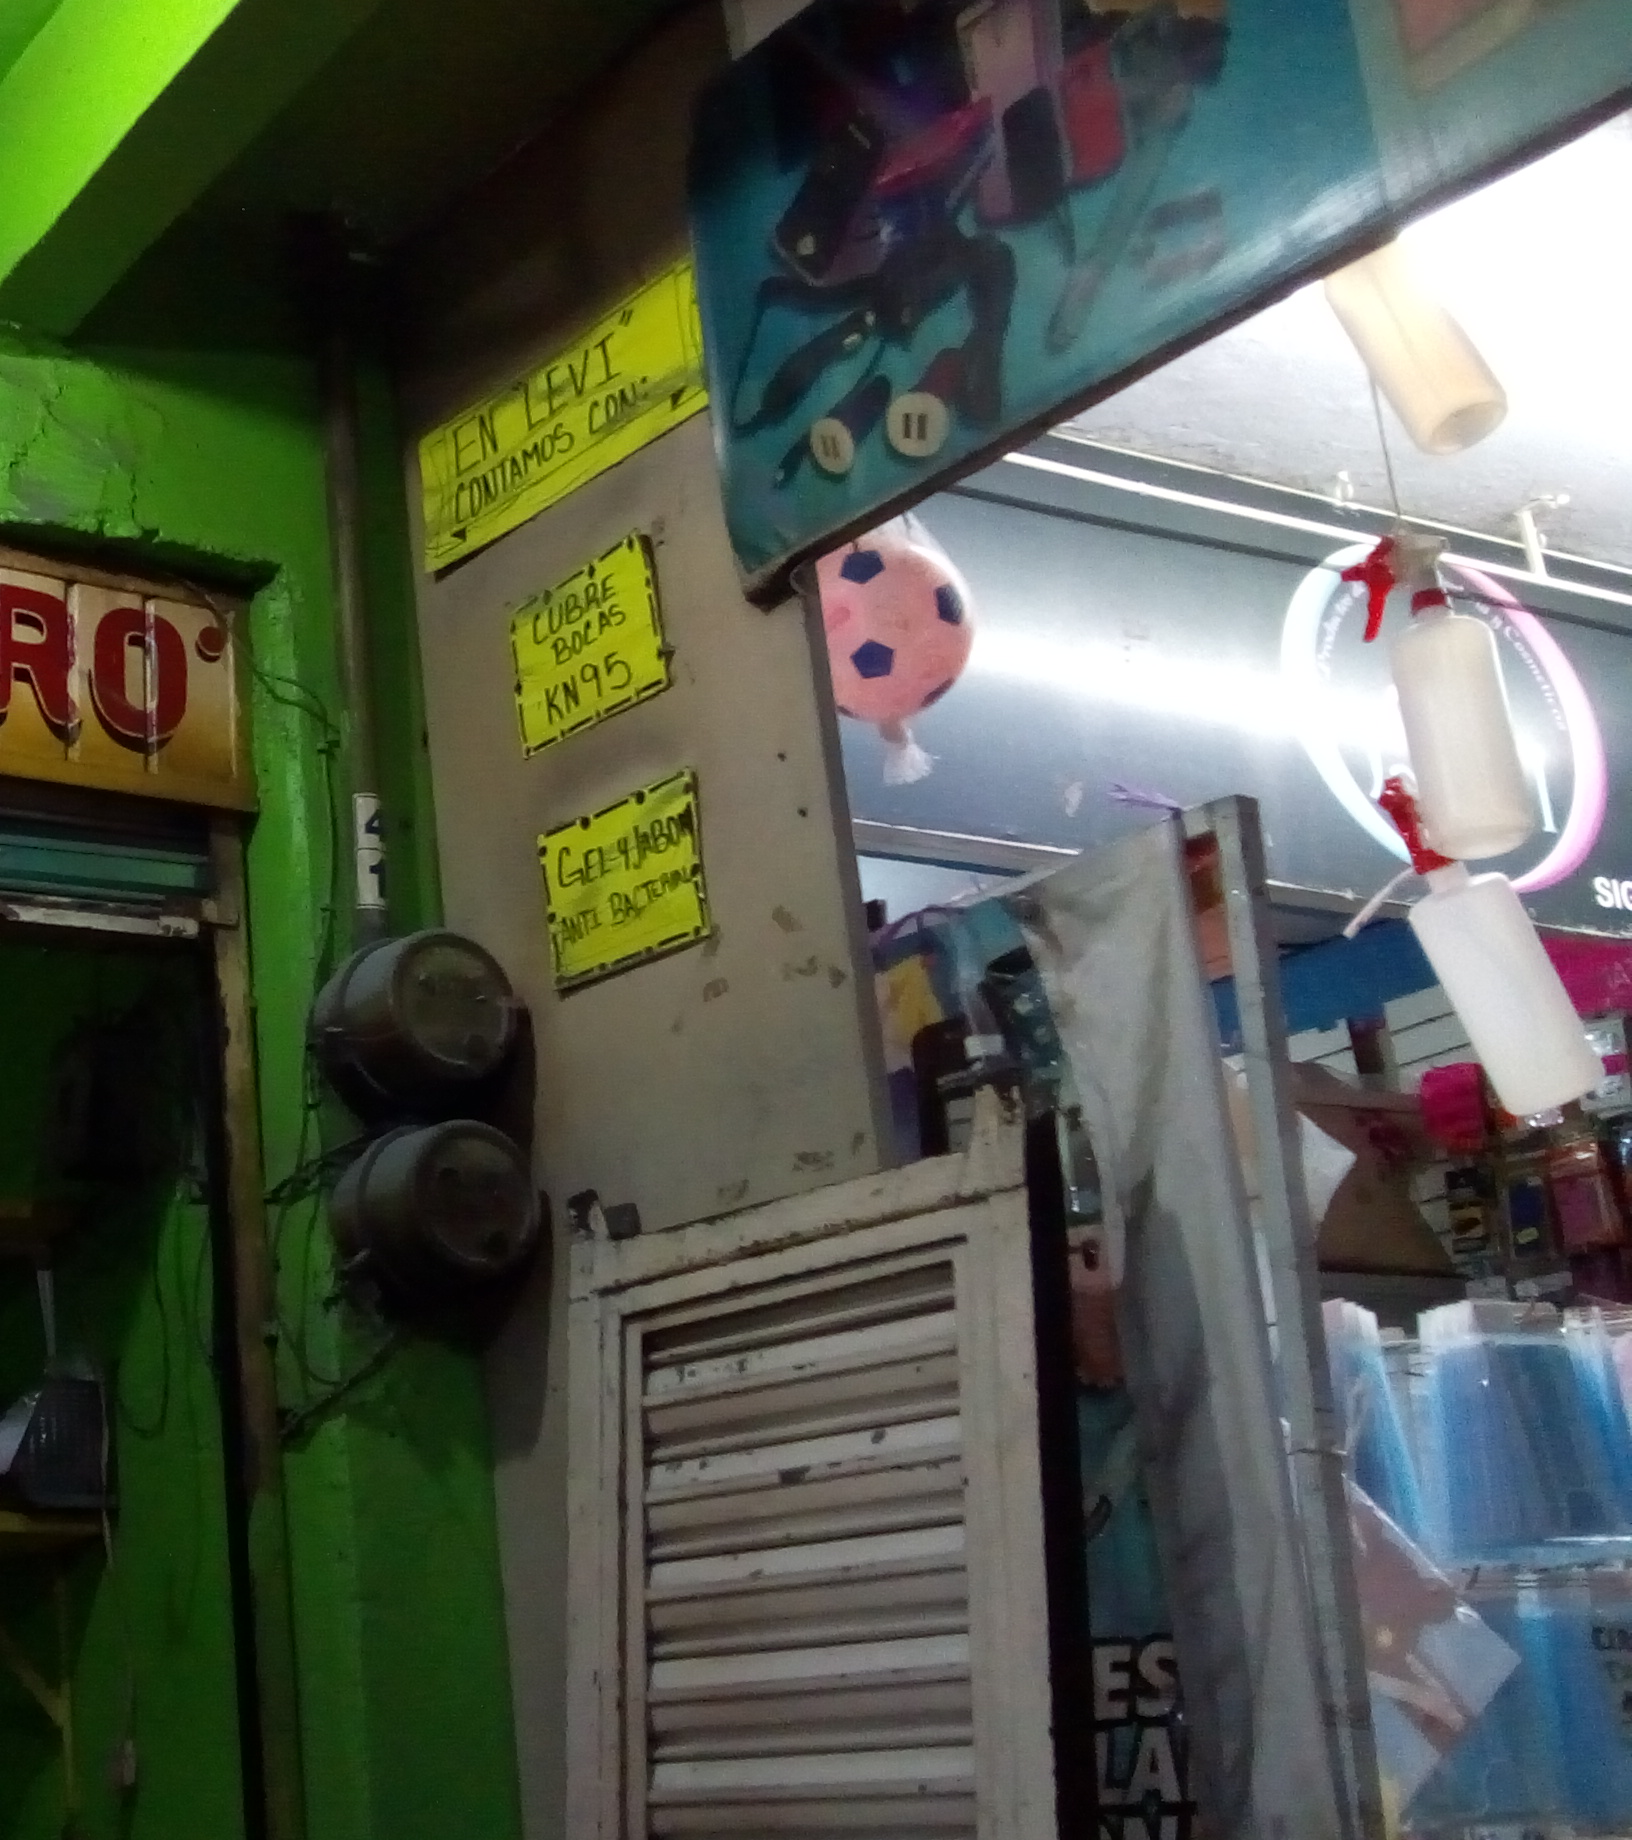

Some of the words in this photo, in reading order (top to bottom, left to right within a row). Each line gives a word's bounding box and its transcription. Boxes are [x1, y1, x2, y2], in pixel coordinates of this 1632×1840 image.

[453, 404, 499, 477] EN
[455, 423, 575, 524] CONTAMOS
[533, 573, 616, 644] CUBRE
[551, 603, 626, 665] BOCAS
[545, 652, 632, 724] KN95
[560, 908, 602, 946] ANTI
